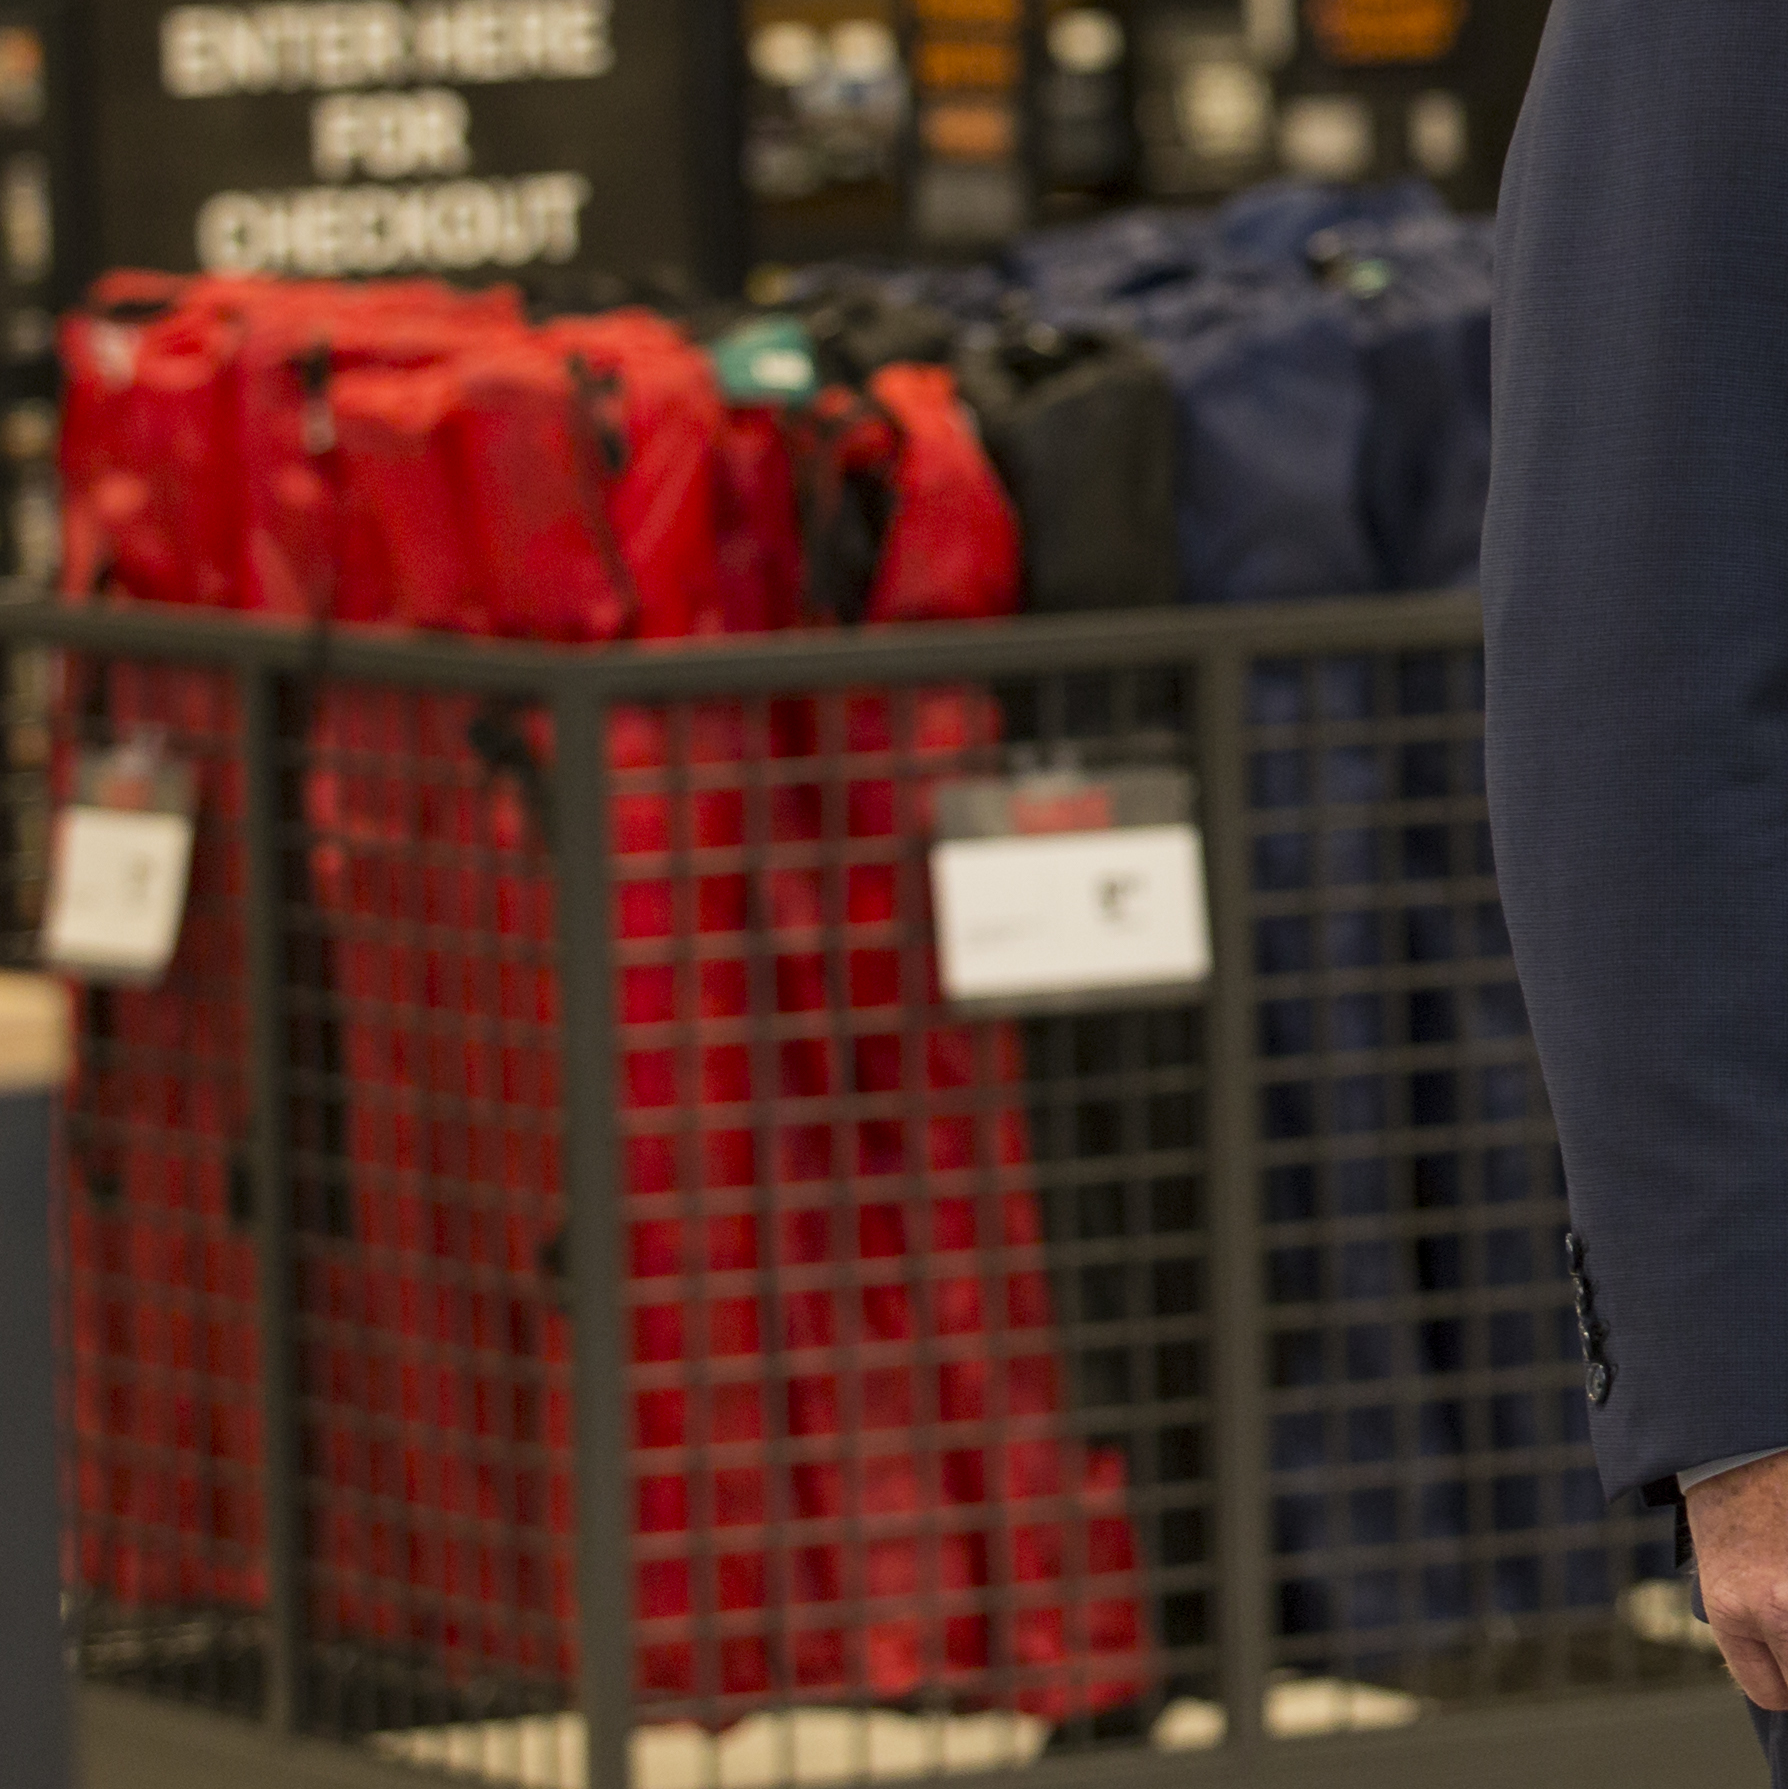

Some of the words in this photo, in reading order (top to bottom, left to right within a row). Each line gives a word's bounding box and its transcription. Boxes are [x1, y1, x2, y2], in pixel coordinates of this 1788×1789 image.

[160, 1, 402, 98] ENTER
[312, 90, 470, 178] FOR
[197, 174, 590, 274] CHECKOUT
